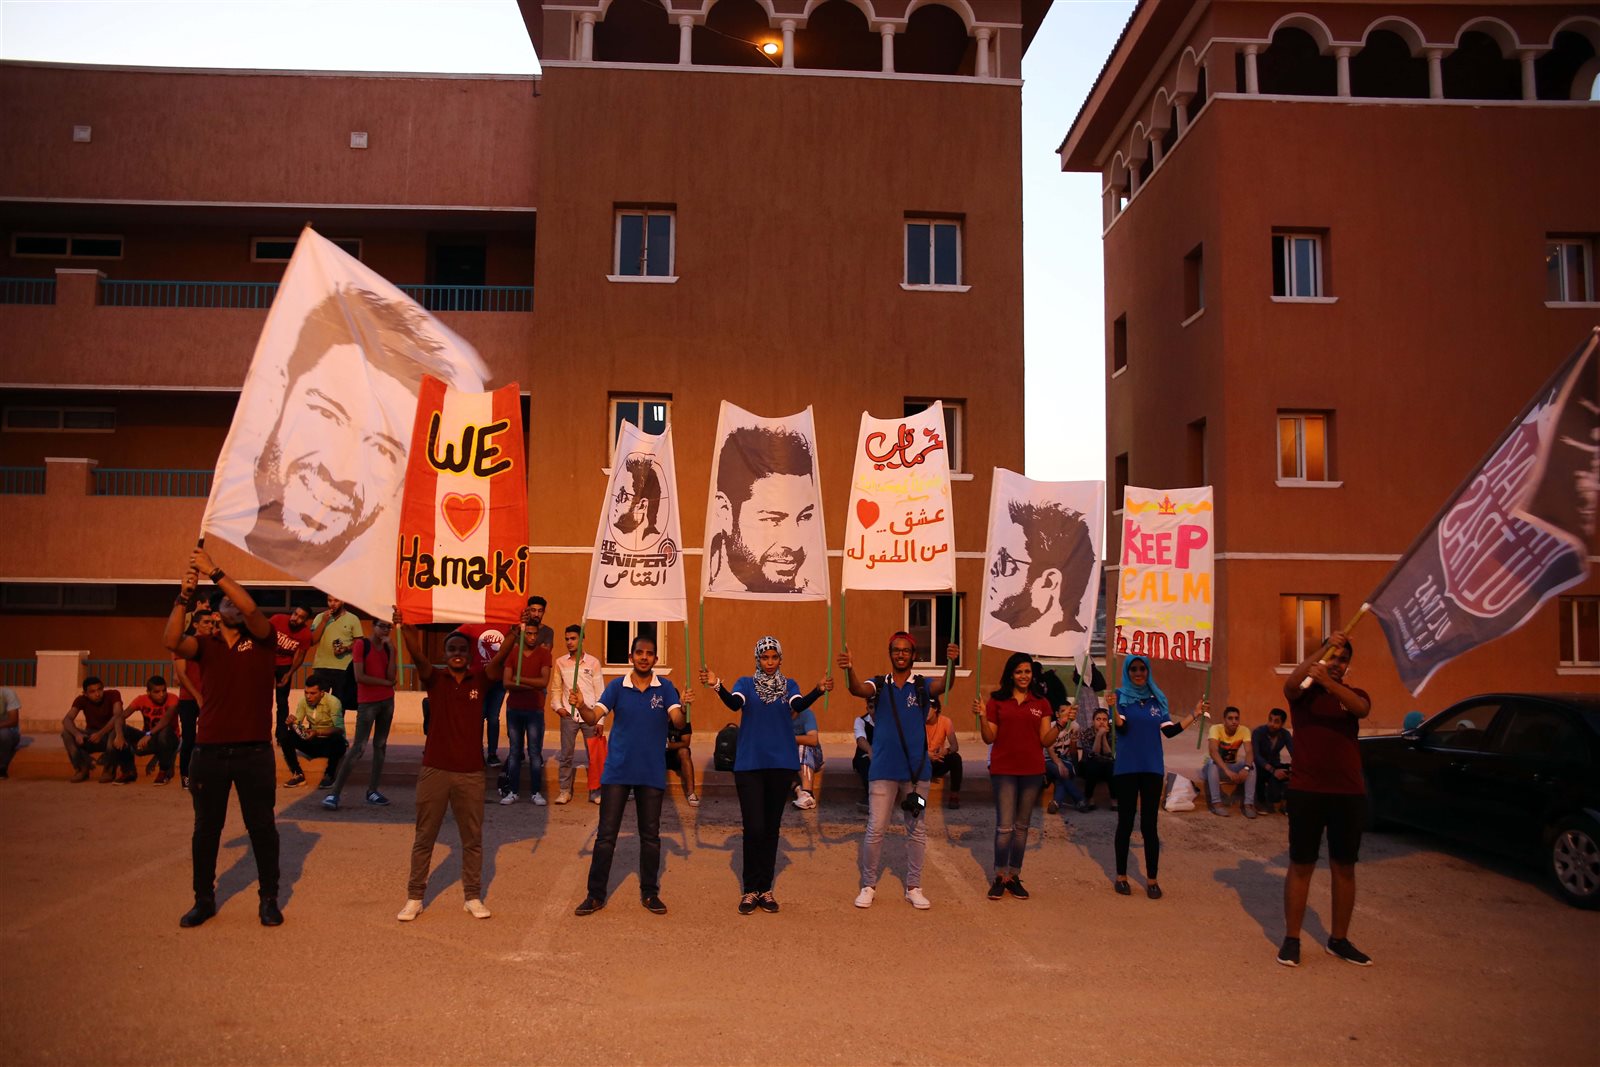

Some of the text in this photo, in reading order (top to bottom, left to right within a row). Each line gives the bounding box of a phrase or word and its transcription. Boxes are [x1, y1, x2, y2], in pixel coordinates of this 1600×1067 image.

[426, 410, 512, 477] WE
[920, 543, 948, 562] من
[1122, 519, 1208, 568] KEEP
[397, 535, 530, 597] Hamaki
[603, 569, 666, 588] القناص
[1121, 567, 1211, 605] CALM
